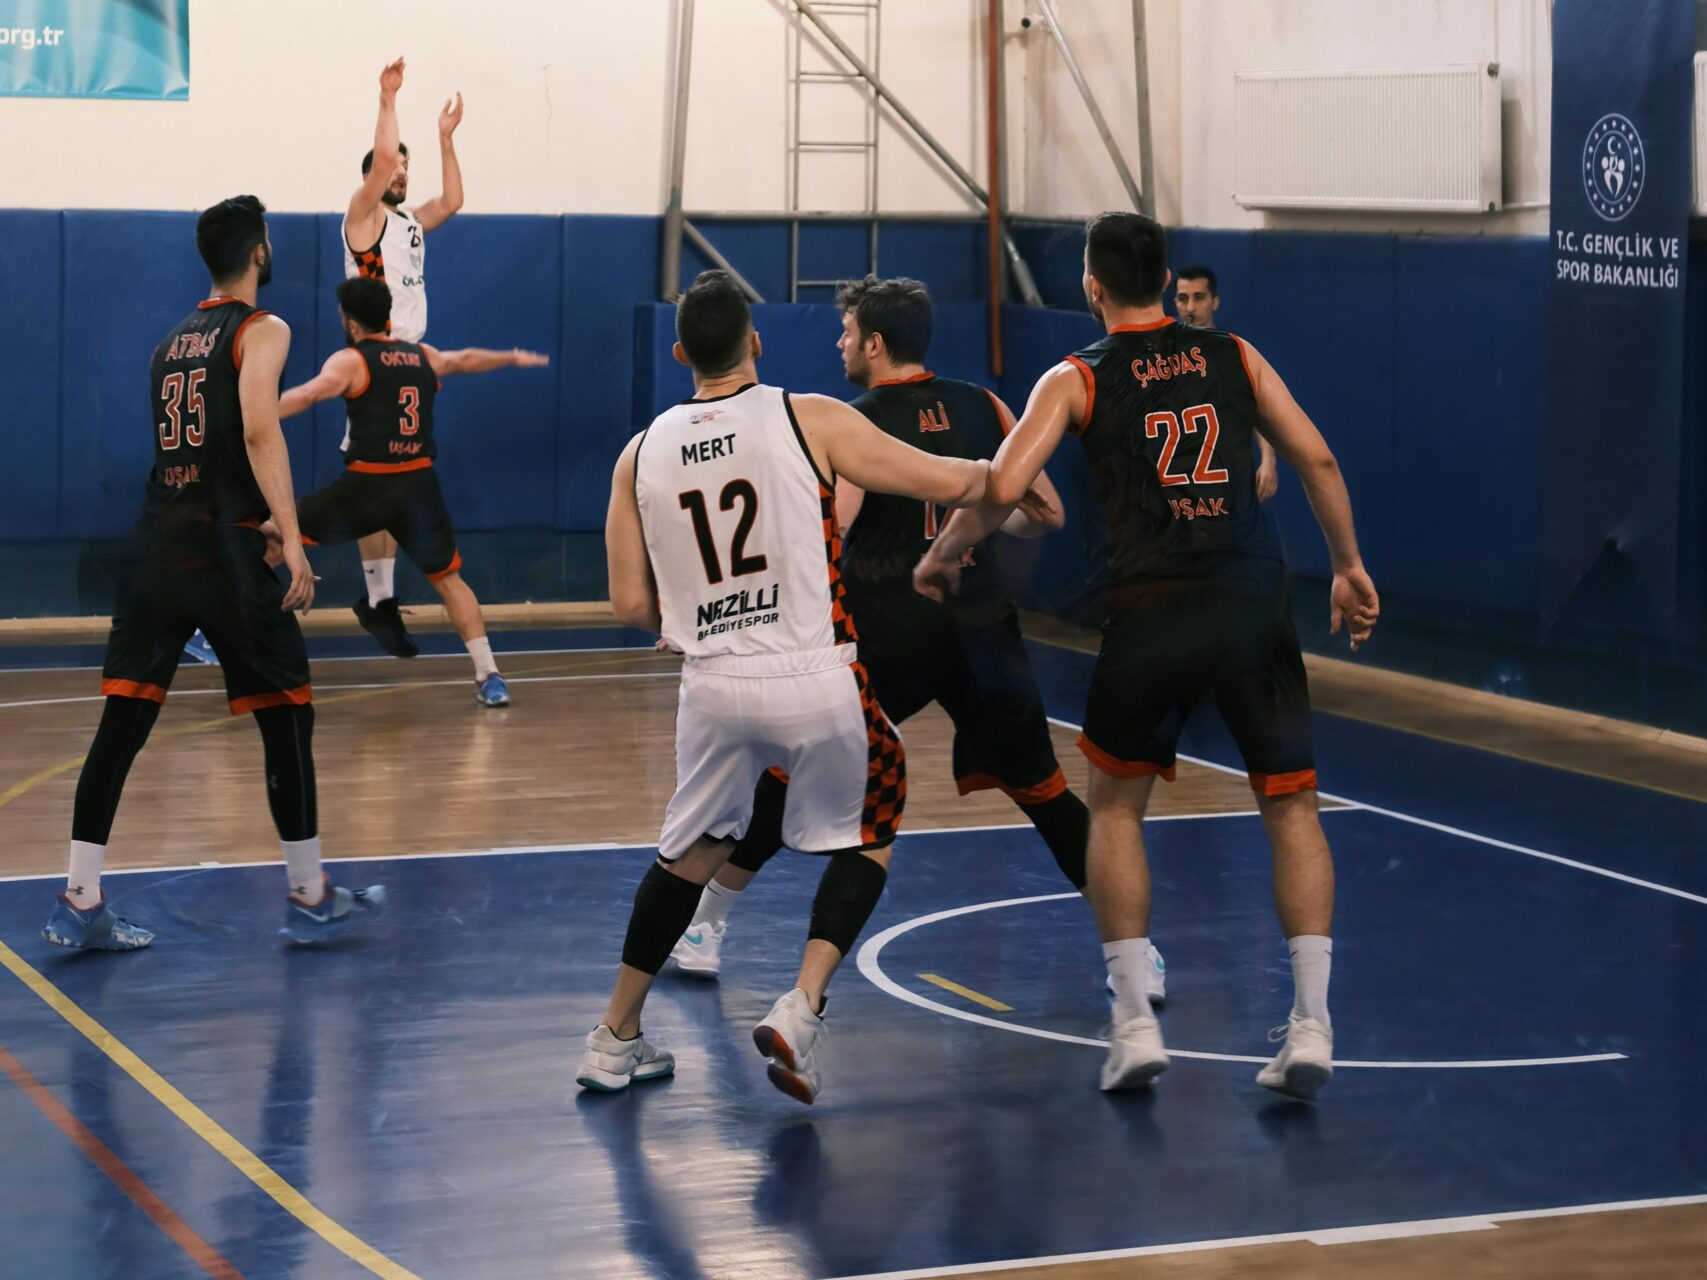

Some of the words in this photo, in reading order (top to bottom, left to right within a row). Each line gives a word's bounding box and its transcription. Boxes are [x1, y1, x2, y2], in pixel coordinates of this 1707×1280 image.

[0, 26, 64, 50] org.tr
[1556, 229, 1579, 252] T.C.
[1582, 232, 1654, 261] GENÇLİK
[1659, 238, 1679, 259] VE
[1557, 258, 1590, 282] SPOR
[1593, 263, 1679, 289] BAKANLIĞI
[1131, 346, 1207, 389] ÇAĞDAŞ
[159, 368, 206, 451] 35
[398, 386, 420, 436] 3
[918, 400, 950, 433] ALİ
[681, 433, 737, 466] MERT
[1145, 403, 1229, 487] 22
[678, 478, 768, 585] 12
[697, 583, 779, 627] NAZİLLİ
[697, 612, 780, 641] BEEDİYESPOR
